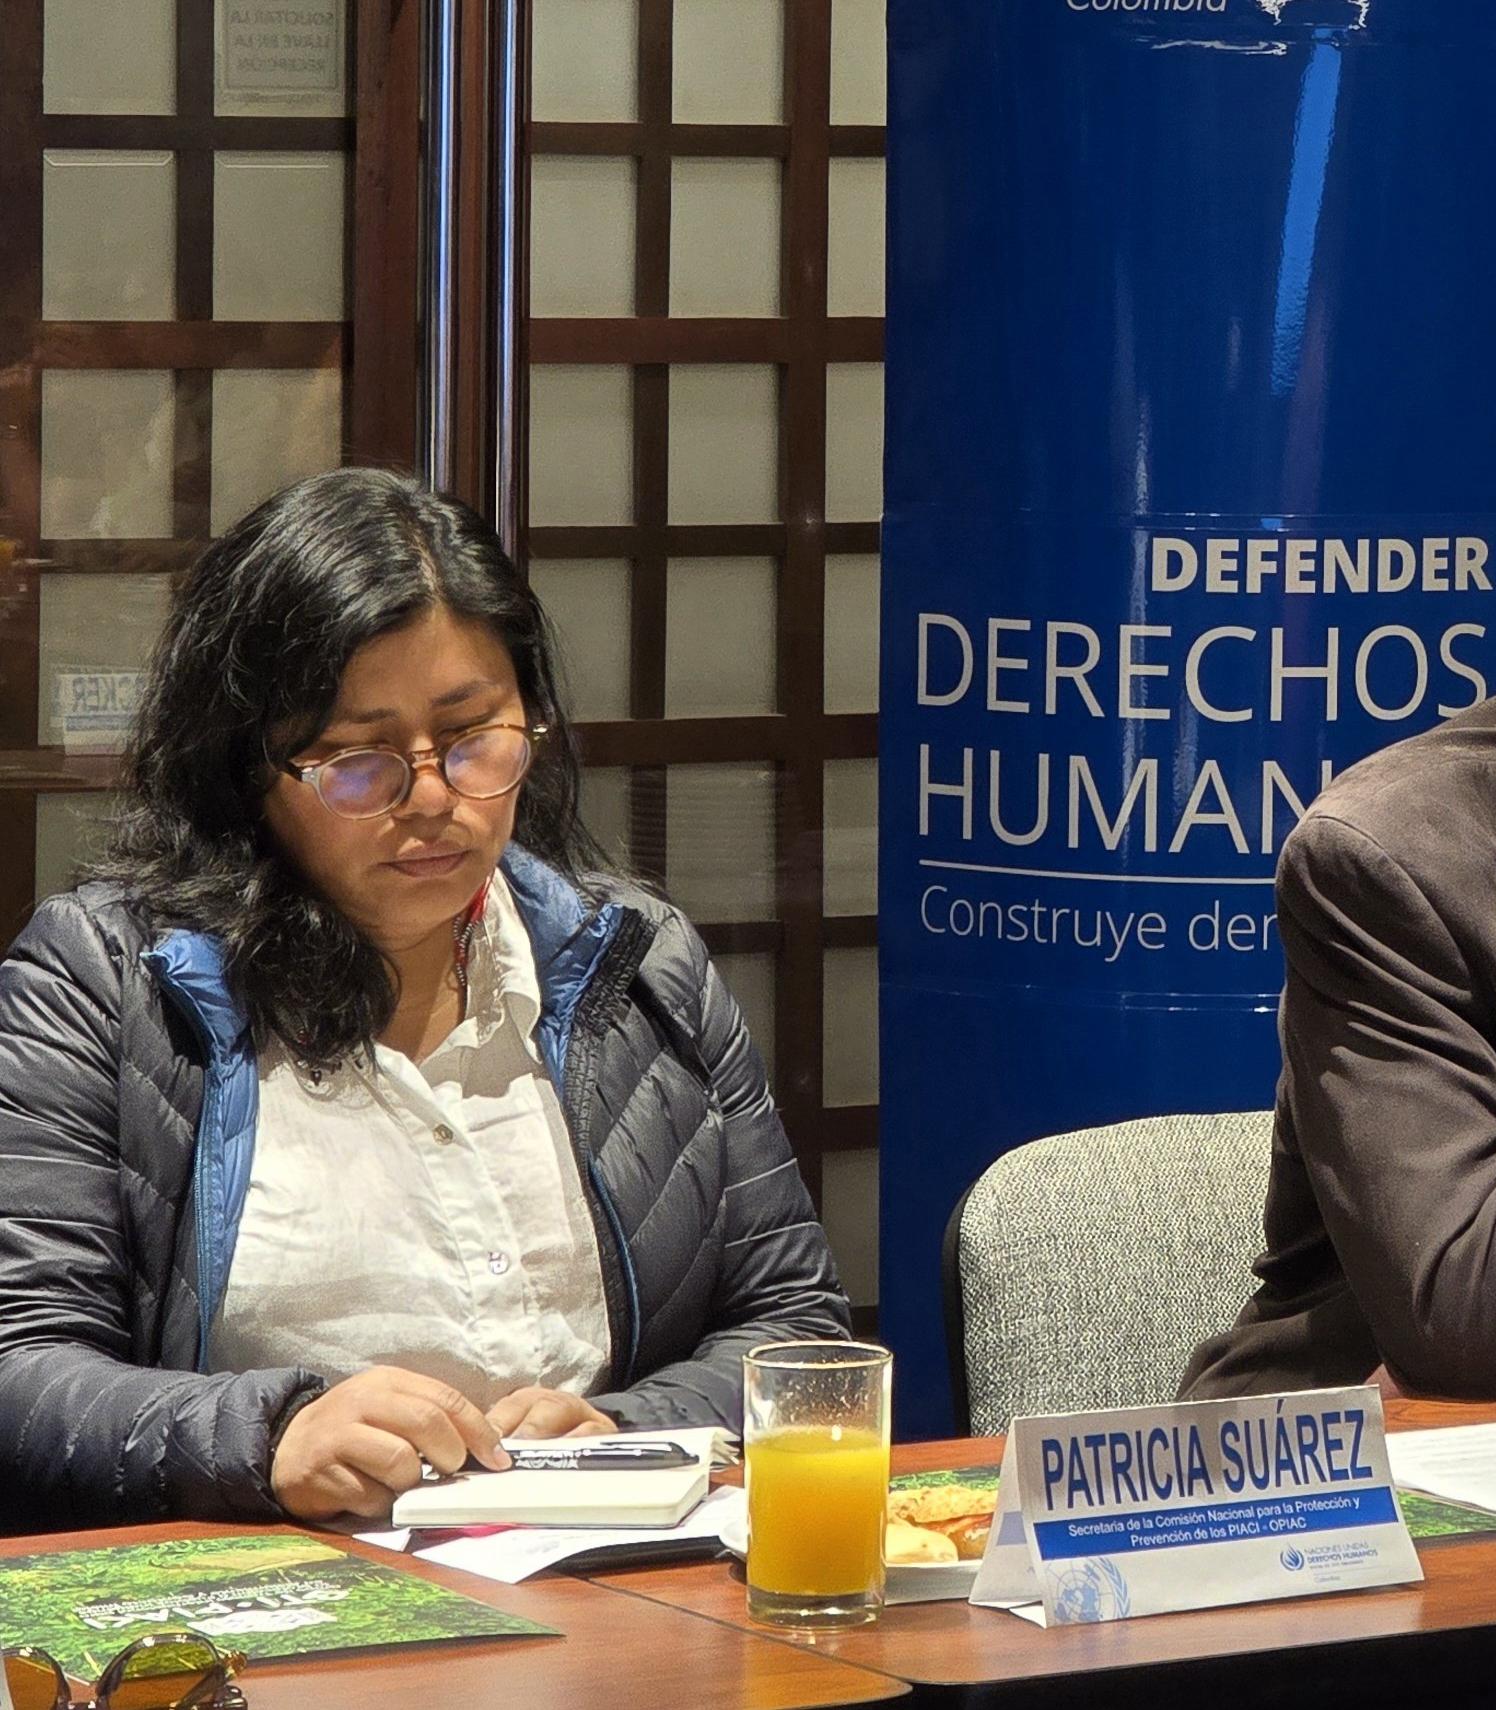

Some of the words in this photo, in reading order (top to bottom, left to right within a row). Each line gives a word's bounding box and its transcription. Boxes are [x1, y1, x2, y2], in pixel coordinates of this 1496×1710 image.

[1151, 536, 1493, 594] DEFENDER
[917, 612, 1487, 722] DERECHOS
[918, 743, 1333, 855] HUMAN
[920, 885, 1167, 962] Construye
[1041, 1424, 1214, 1511] PATRICIA
[1220, 1399, 1373, 1494] SUÁREZ
[1127, 1518, 1141, 1531] de
[1143, 1517, 1154, 1529] la
[1155, 1512, 1206, 1527] Comisión
[1208, 1505, 1255, 1521] Nacional
[1257, 1506, 1282, 1520] para
[1283, 1501, 1294, 1514] la
[1296, 1496, 1349, 1512] Protección
[1351, 1497, 1360, 1509] y
[1131, 1527, 1192, 1547] Prevención
[1193, 1527, 1208, 1541] de
[1210, 1524, 1227, 1538] los
[1229, 1519, 1260, 1536] PIACI
[1269, 1516, 1307, 1532] OPIAC
